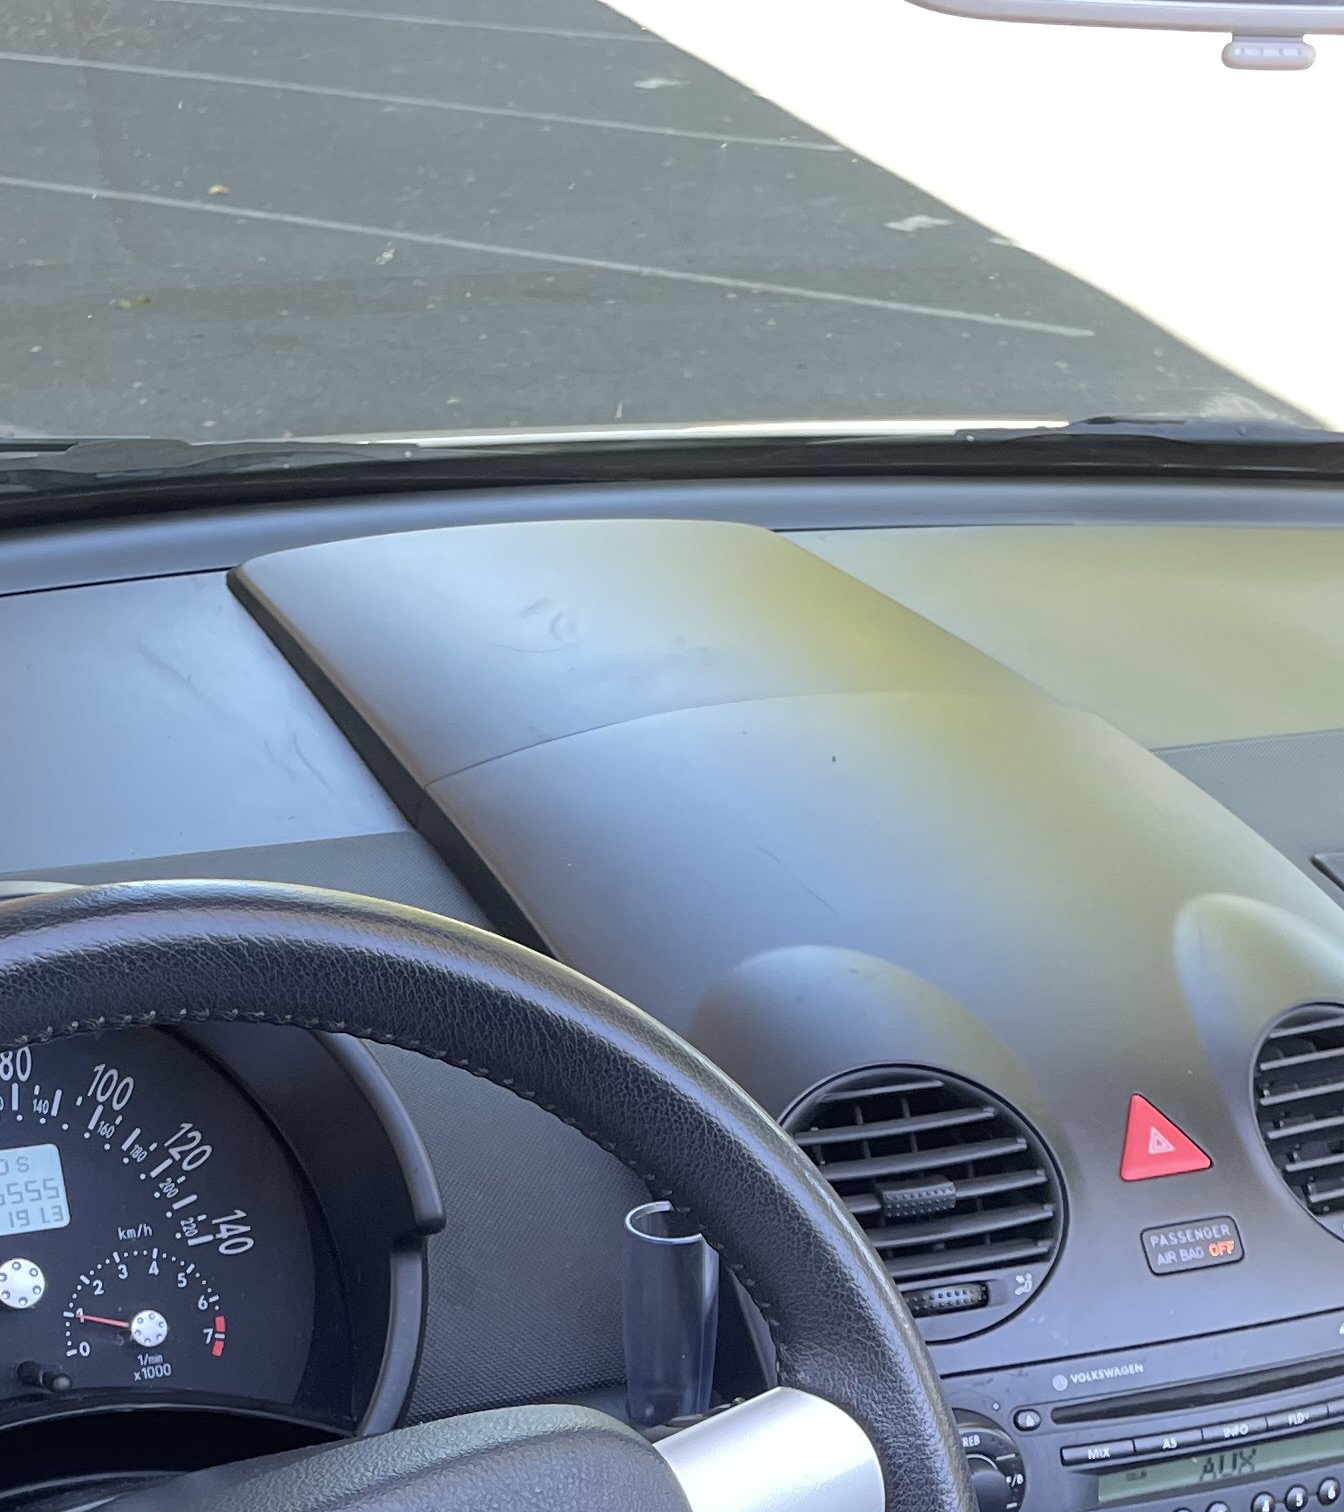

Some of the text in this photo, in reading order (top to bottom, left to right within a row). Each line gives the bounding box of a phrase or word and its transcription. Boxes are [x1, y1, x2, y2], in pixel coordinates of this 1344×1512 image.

[88, 1063, 134, 1111] 100
[32, 1098, 50, 1115] 140
[97, 1120, 115, 1139] 160
[129, 1143, 147, 1162] 180
[164, 1122, 213, 1171] 120
[158, 1177, 179, 1198] 200
[117, 1223, 153, 1241] km/h
[180, 1217, 199, 1237] 220
[212, 1209, 255, 1255] 140
[1157, 1250, 1178, 1266] AIR
[1208, 1240, 1235, 1257] OFF
[117, 1264, 129, 1279] 3
[148, 1260, 159, 1276] 4
[92, 1280, 104, 1296] 2
[177, 1272, 188, 1288] 5
[197, 1295, 208, 1310] 6
[202, 1328, 214, 1344] 7
[79, 1341, 91, 1357] 0
[133, 1363, 172, 1382] x1000
[1070, 1363, 1145, 1385] VOLKSWAGEN
[960, 1434, 981, 1448] REB
[1087, 1447, 1111, 1460] MIX
[1199, 1448, 1256, 1482] AUX
